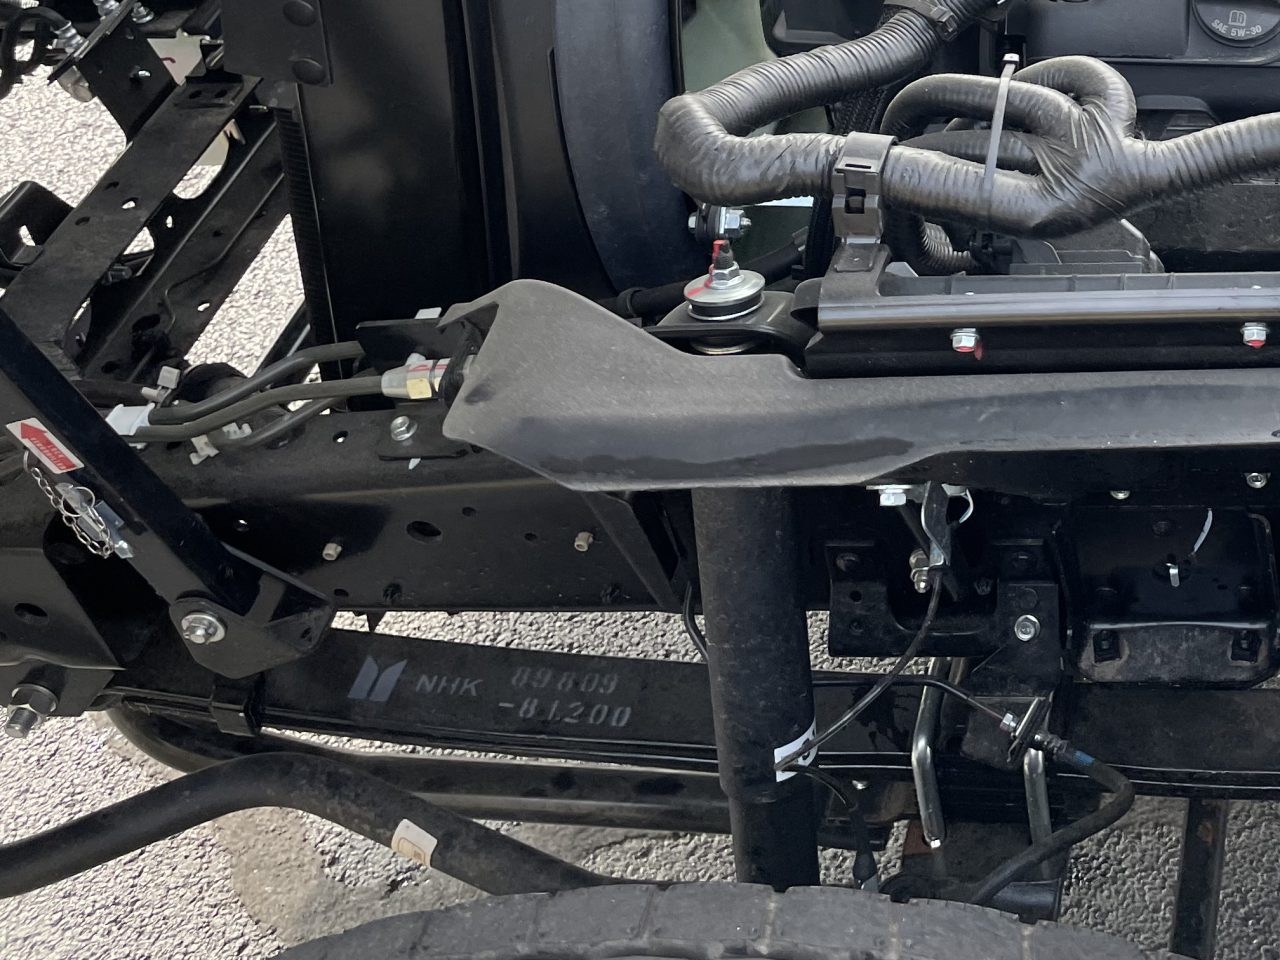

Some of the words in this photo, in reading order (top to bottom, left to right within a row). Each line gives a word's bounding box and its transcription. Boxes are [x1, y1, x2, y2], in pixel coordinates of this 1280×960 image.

[1211, 19, 1228, 33] SAE
[1230, 25, 1262, 37] 5W-30
[415, 674, 484, 696] NHK
